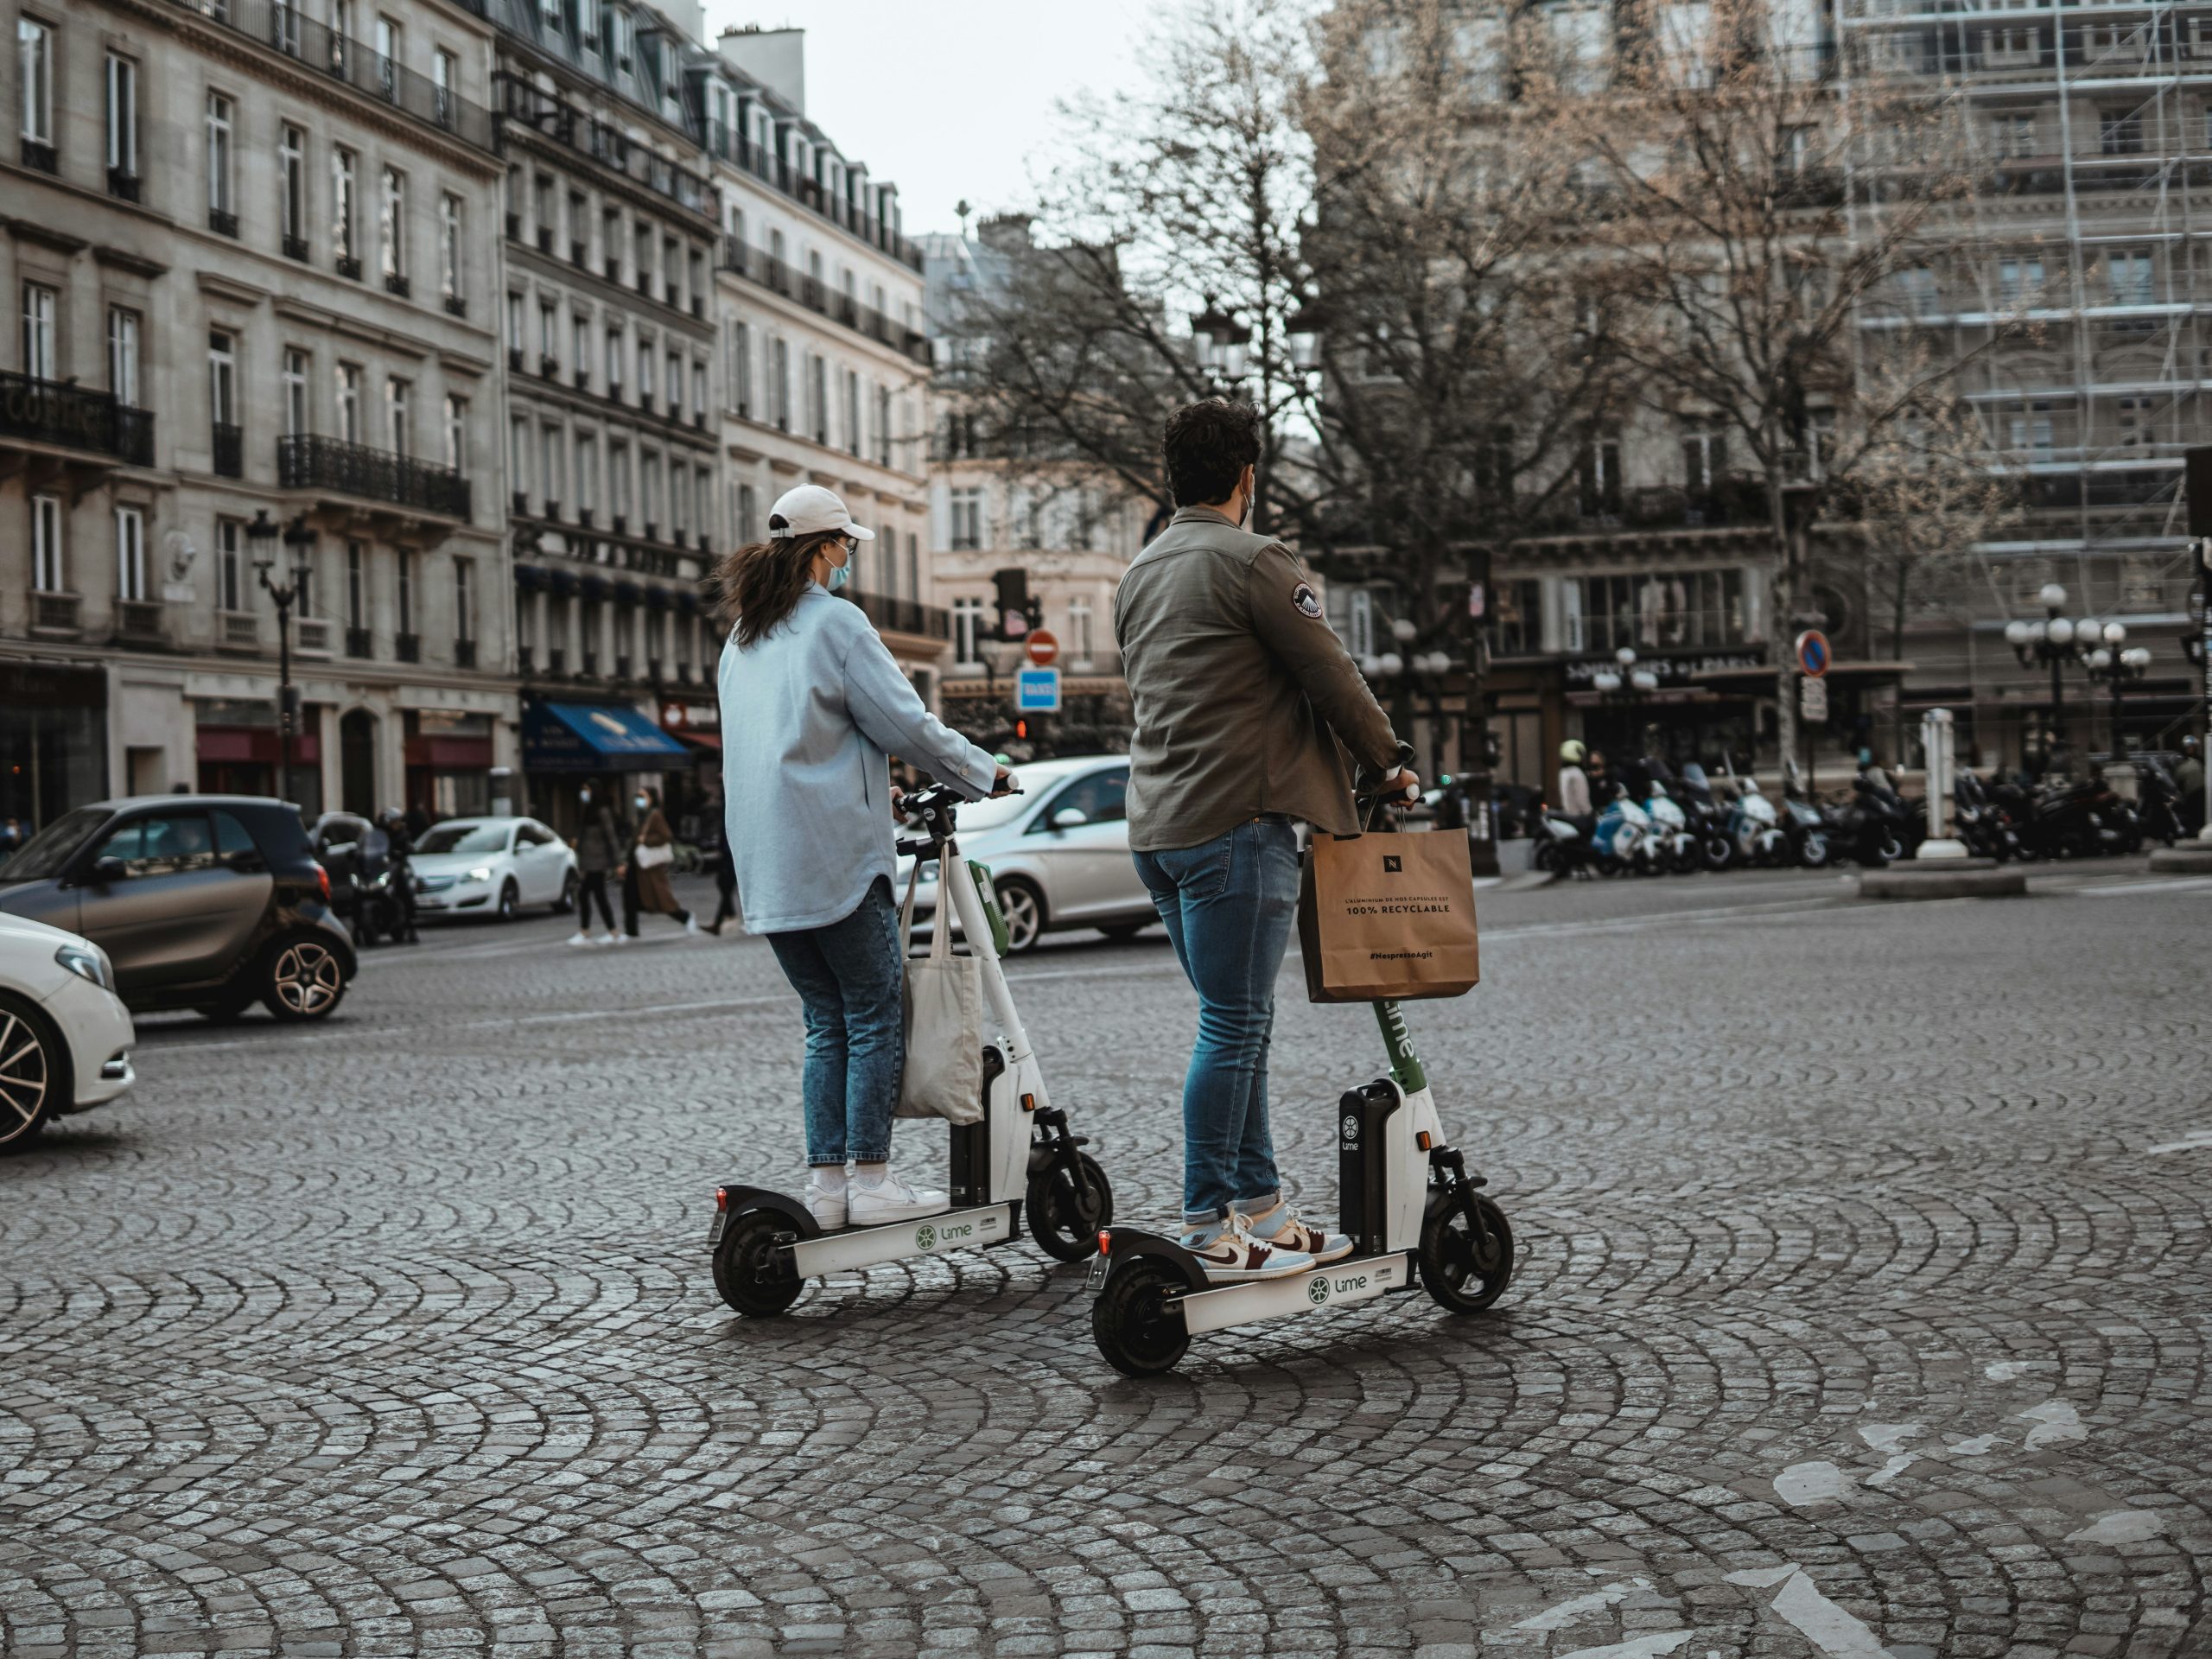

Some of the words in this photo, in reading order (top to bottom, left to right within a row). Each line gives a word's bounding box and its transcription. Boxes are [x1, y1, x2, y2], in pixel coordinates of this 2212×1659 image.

[1567, 659, 1672, 680] SOUVIRS
[1382, 905, 1450, 913] RECYCLABLE
[1370, 950, 1433, 960] #NespressoAgit
[1384, 1001, 1414, 1058] ime
